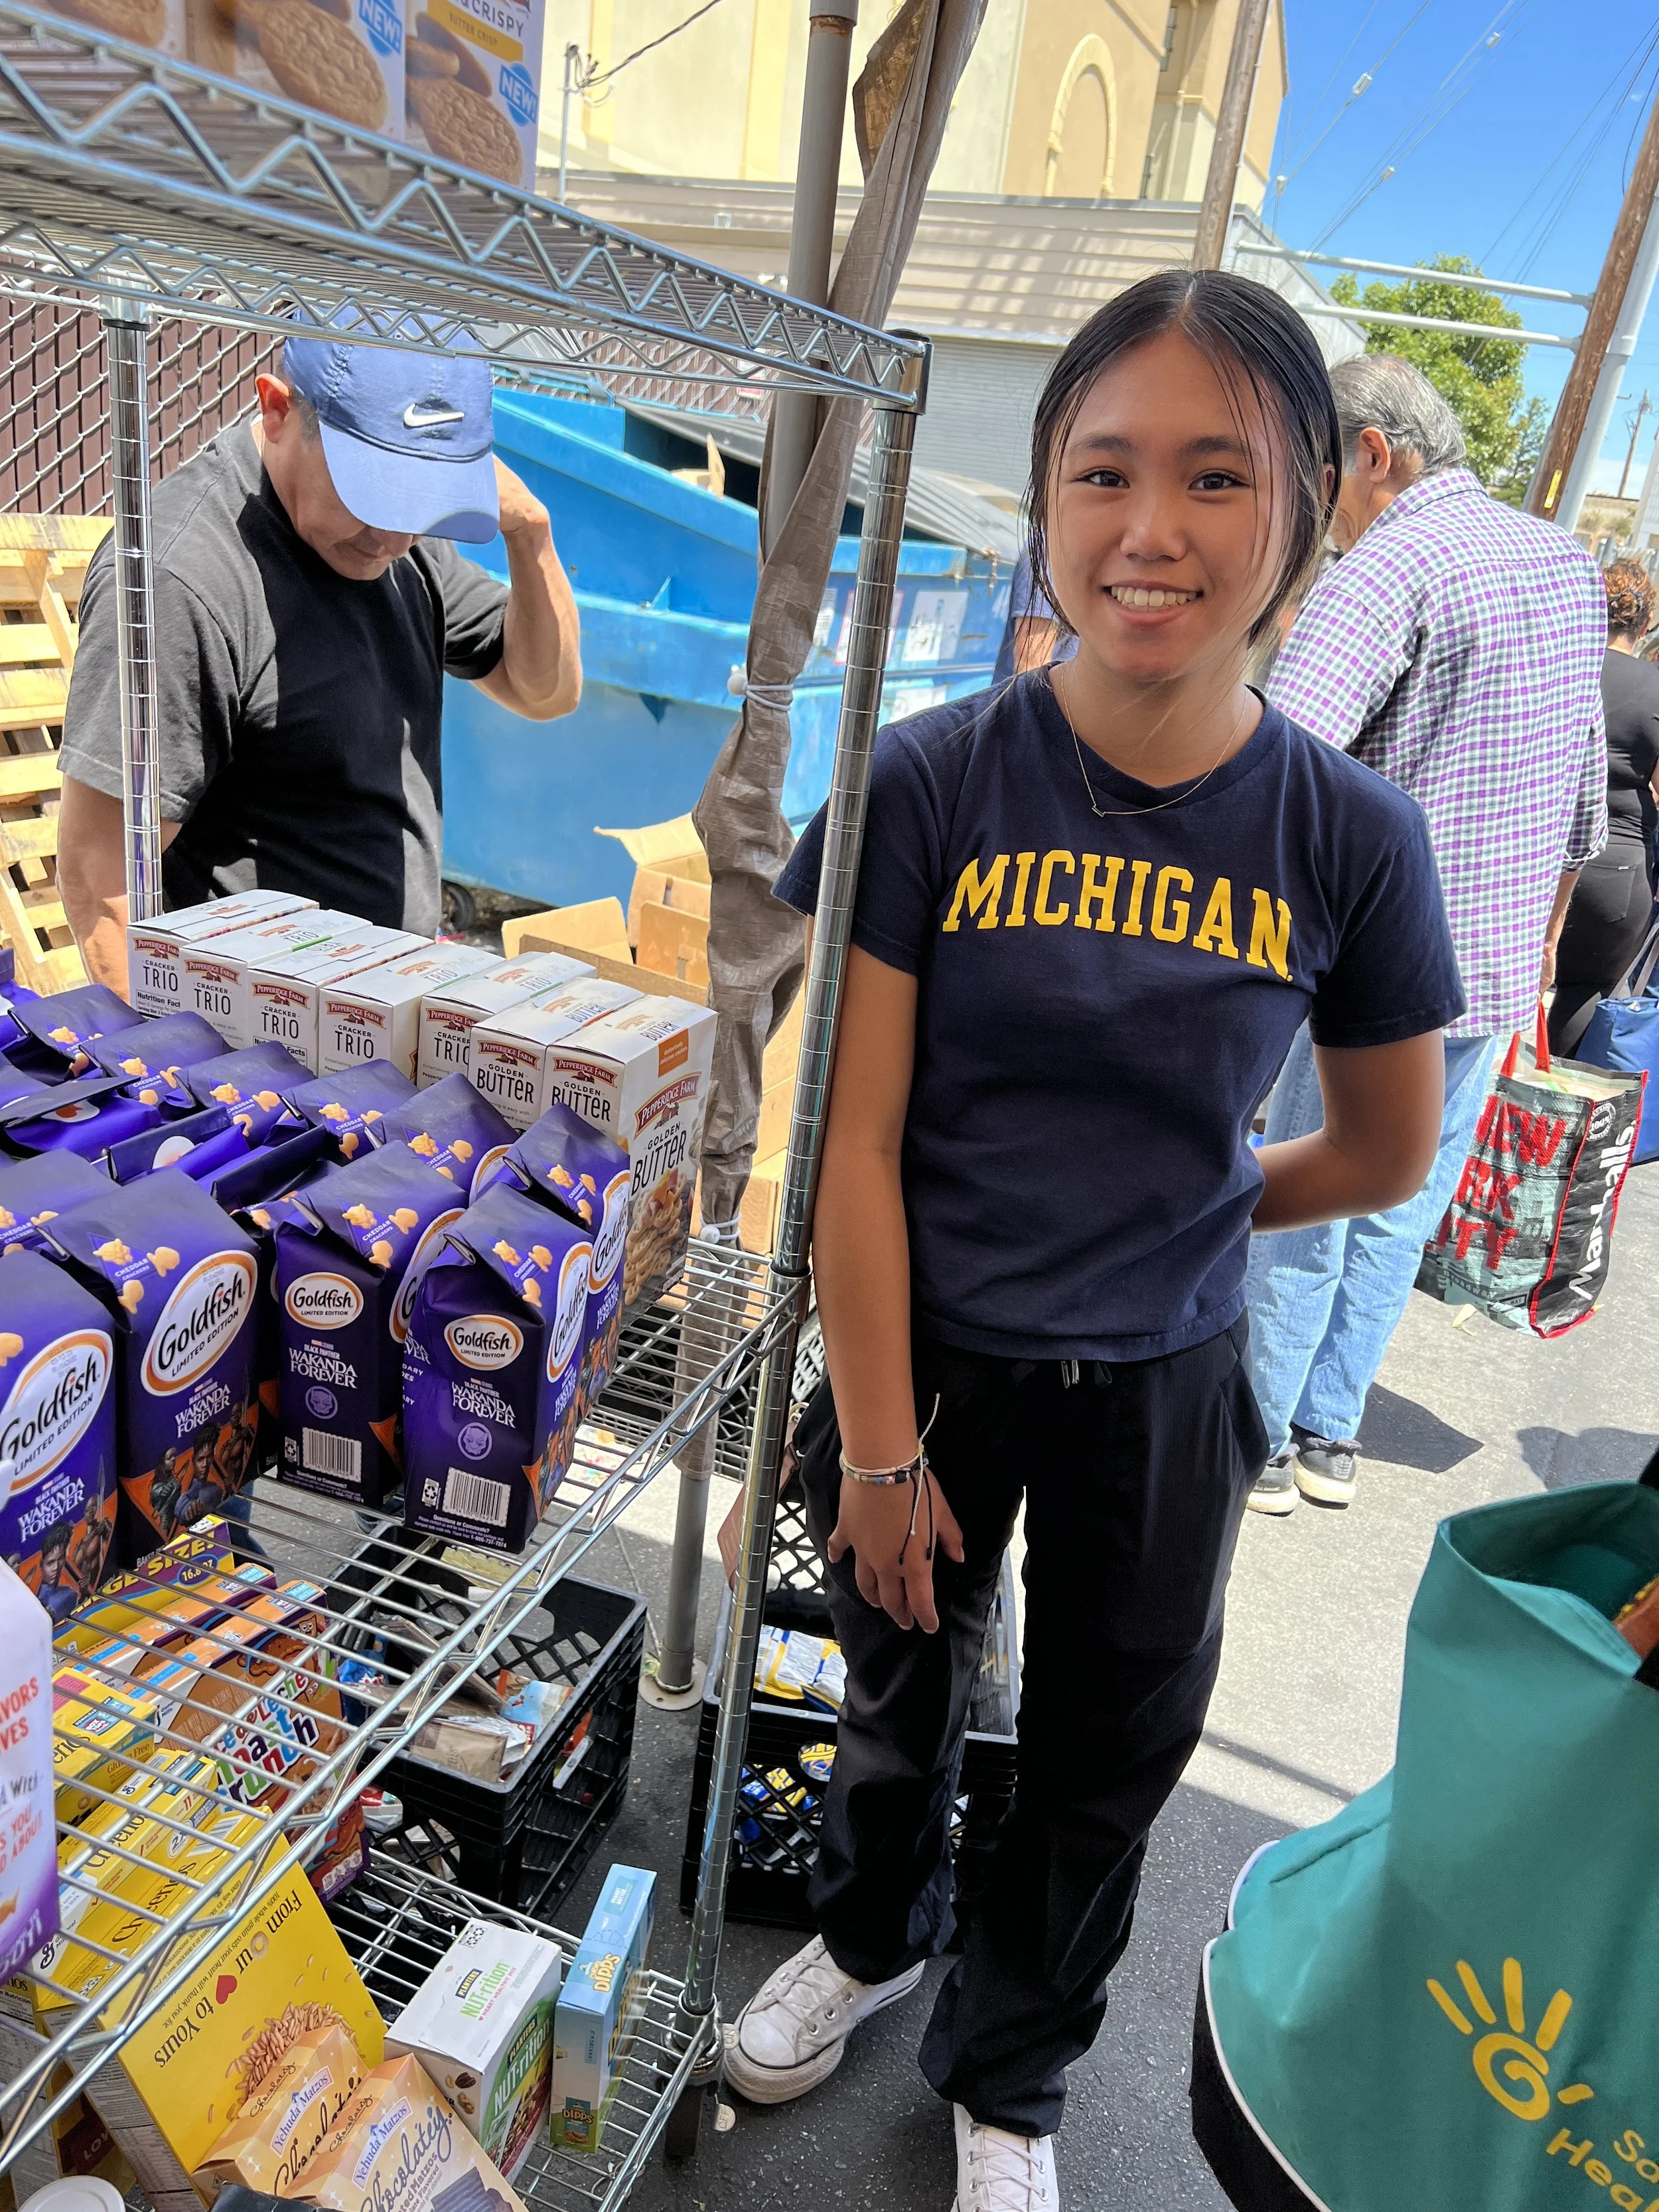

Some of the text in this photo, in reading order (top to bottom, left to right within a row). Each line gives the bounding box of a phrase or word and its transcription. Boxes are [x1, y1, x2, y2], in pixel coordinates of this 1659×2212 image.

[500, 76, 538, 122] NEW!
[942, 849, 1292, 979] MICHIGAN
[137, 940, 166, 950] PEPPERIDGE
[145, 960, 175, 971] CRACKER
[189, 962, 235, 979] PEPPERIDGE FARM
[143, 966, 178, 992] TRIO
[423, 969, 459, 985] TRIO
[520, 977, 552, 993] TRIO
[197, 982, 228, 994] CRACKER
[257, 986, 304, 1003] PEPPERIDGE FARM
[137, 992, 165, 1005] Nutrition
[194, 988, 231, 1015] TRIO
[264, 1005, 297, 1018] CRACKER
[331, 1003, 380, 1023] PEPPERIDGE FARM
[431, 1011, 464, 1023] PEPPERIDGE
[261, 1012, 299, 1039] TRIO
[338, 1025, 372, 1038] CRACKER
[287, 1047, 305, 1057] Facts
[335, 1030, 374, 1059] TRIO
[483, 1043, 534, 1063] PEPPERIDGE FARM
[488, 1064, 524, 1078] GOLDEN
[558, 1060, 611, 1081] PEPPERIDGE FARM
[133, 1075, 161, 1088] CHEDDAR
[138, 1079, 163, 1090] CRACKERS
[564, 1081, 601, 1096] GOLDEN
[232, 1103, 255, 1116] CRACKERS
[641, 1080, 695, 1126] PEPPERIDGE FARM
[336, 1118, 363, 1131] CHEDDAR
[342, 1123, 364, 1133] CRACKERS
[648, 1122, 681, 1150] GOLDEN
[432, 1154, 453, 1168] CRACKERS
[568, 1181, 585, 1200] CHEDDAR
[1453, 1156, 1524, 1221] RK
[0, 1222, 33, 1240] CHEDDAR
[4, 1228, 34, 1244] CRACKERS
[362, 1220, 392, 1241] CHEDDAR
[368, 1225, 393, 1244] CRACKERS
[115, 1258, 149, 1278] CHEDDAR
[121, 1265, 150, 1281] CRACKERS
[514, 1257, 533, 1278] CHEDDAR
[293, 1287, 353, 1308] Goldfish
[158, 1270, 244, 1370] Goldfish
[171, 1308, 239, 1377] LIMITED EDITION
[453, 1327, 509, 1351] Goldfish
[289, 1347, 358, 1378] WAKANDA
[461, 1348, 480, 1357] LIMITED
[290, 1361, 358, 1389] FOREVER
[0, 1352, 98, 1460] Goldfish
[175, 1383, 231, 1422] WAKANDA
[451, 1380, 516, 1418] WAKANDA
[177, 1394, 231, 1439] FOREVER
[453, 1395, 516, 1429] FOREVER
[15, 1393, 94, 1476] LIMITED EDITION
[18, 1476, 86, 1528] WAKANDA
[21, 1490, 86, 1544] FOREVER
[75, 1708, 98, 1726] DOWNLOAD
[85, 1718, 100, 1731] BOX
[133, 1743, 150, 1757] Free
[267, 1891, 280, 1908] 100%
[253, 1905, 269, 1923] whole
[266, 1889, 303, 1934] From
[240, 1919, 255, 1938] grain
[231, 1935, 243, 1949] oats
[220, 1946, 233, 1964] your
[208, 1958, 223, 1978] heart
[198, 1974, 209, 1991] will
[458, 1969, 482, 1998] PLANTERS
[482, 1966, 517, 2016] HEART HEALTHY MIX
[182, 1986, 200, 2008] thank
[171, 2002, 184, 2020] you
[195, 1996, 214, 2019] to
[153, 2016, 201, 2069] Yours
[508, 2017, 538, 2063] PLANTERS
[723, 2028, 735, 2045] ON
[274, 2075, 328, 2148] Yehuda Matzos
[717, 2108, 729, 2130] OFF
[355, 2105, 407, 2183] Yehuda Matzos
[410, 2152, 438, 2193] Matzos
[419, 2165, 439, 2197] Flavored
